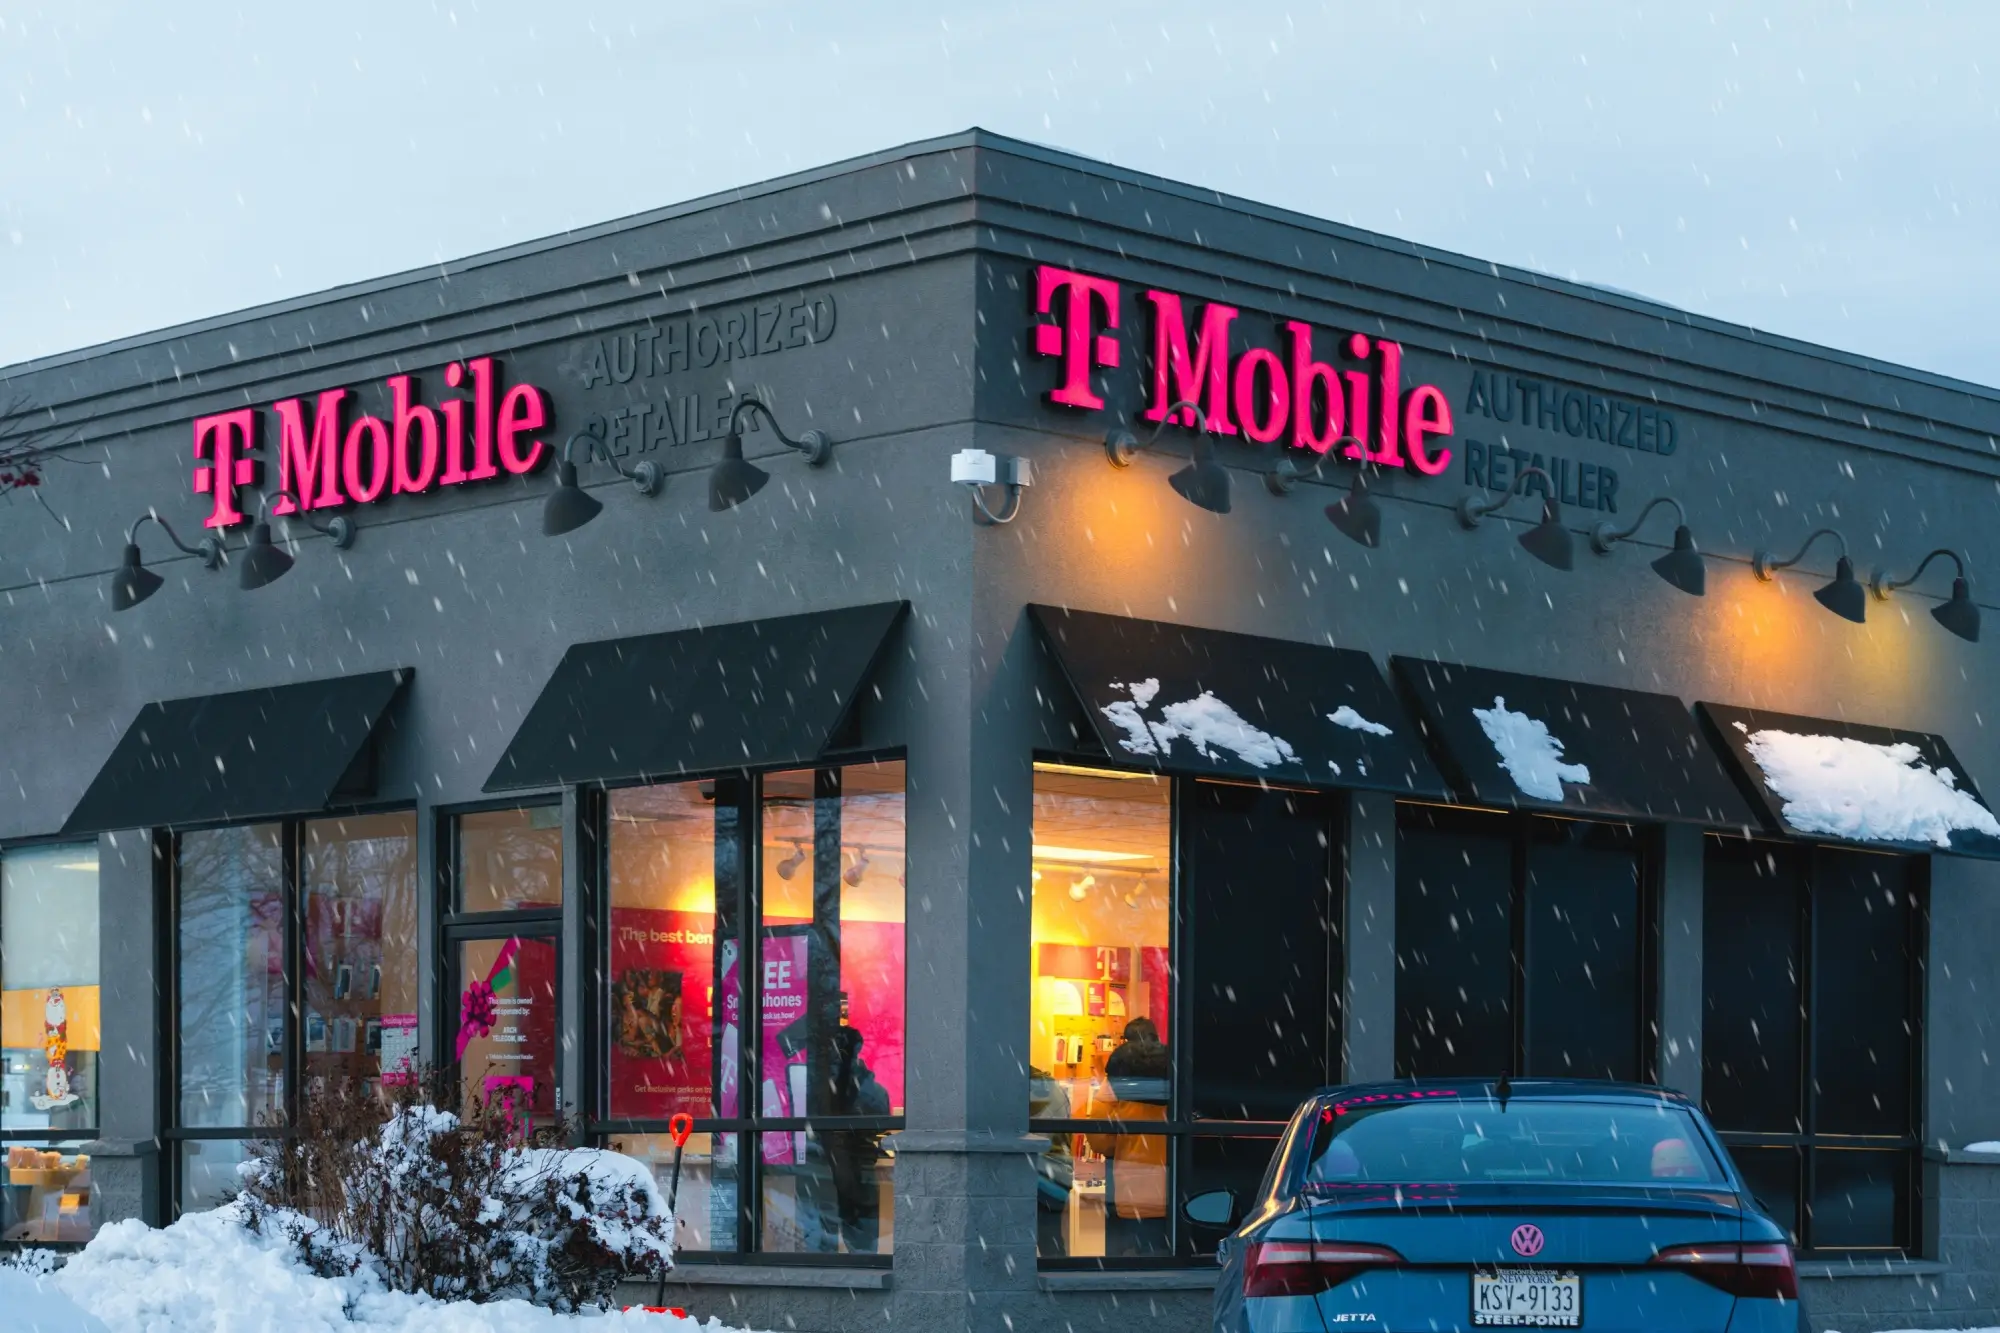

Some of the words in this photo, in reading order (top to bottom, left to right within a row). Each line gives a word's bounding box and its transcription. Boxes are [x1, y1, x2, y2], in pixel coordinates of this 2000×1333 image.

[583, 292, 838, 390] AUTHORIZED
[1035, 265, 1120, 411] T
[1144, 289, 1455, 476] Mobile
[584, 391, 762, 464] RETAILER
[1465, 370, 1680, 456] AUTHORIZED
[193, 408, 255, 529] T
[272, 356, 546, 517] Mobile
[1464, 438, 1620, 514] RETAILER
[620, 926, 648, 942] The
[651, 928, 683, 943] best
[686, 929, 713, 944] ben
[1096, 946, 1118, 980] T
[1480, 1284, 1514, 1311] KSV
[1528, 1285, 1573, 1311] 9133
[1499, 1275, 1522, 1284] NEW
[1527, 1275, 1554, 1284] YORK
[1332, 1313, 1376, 1323] JETTA
[1474, 1315, 1579, 1326] STEET-PONTE
